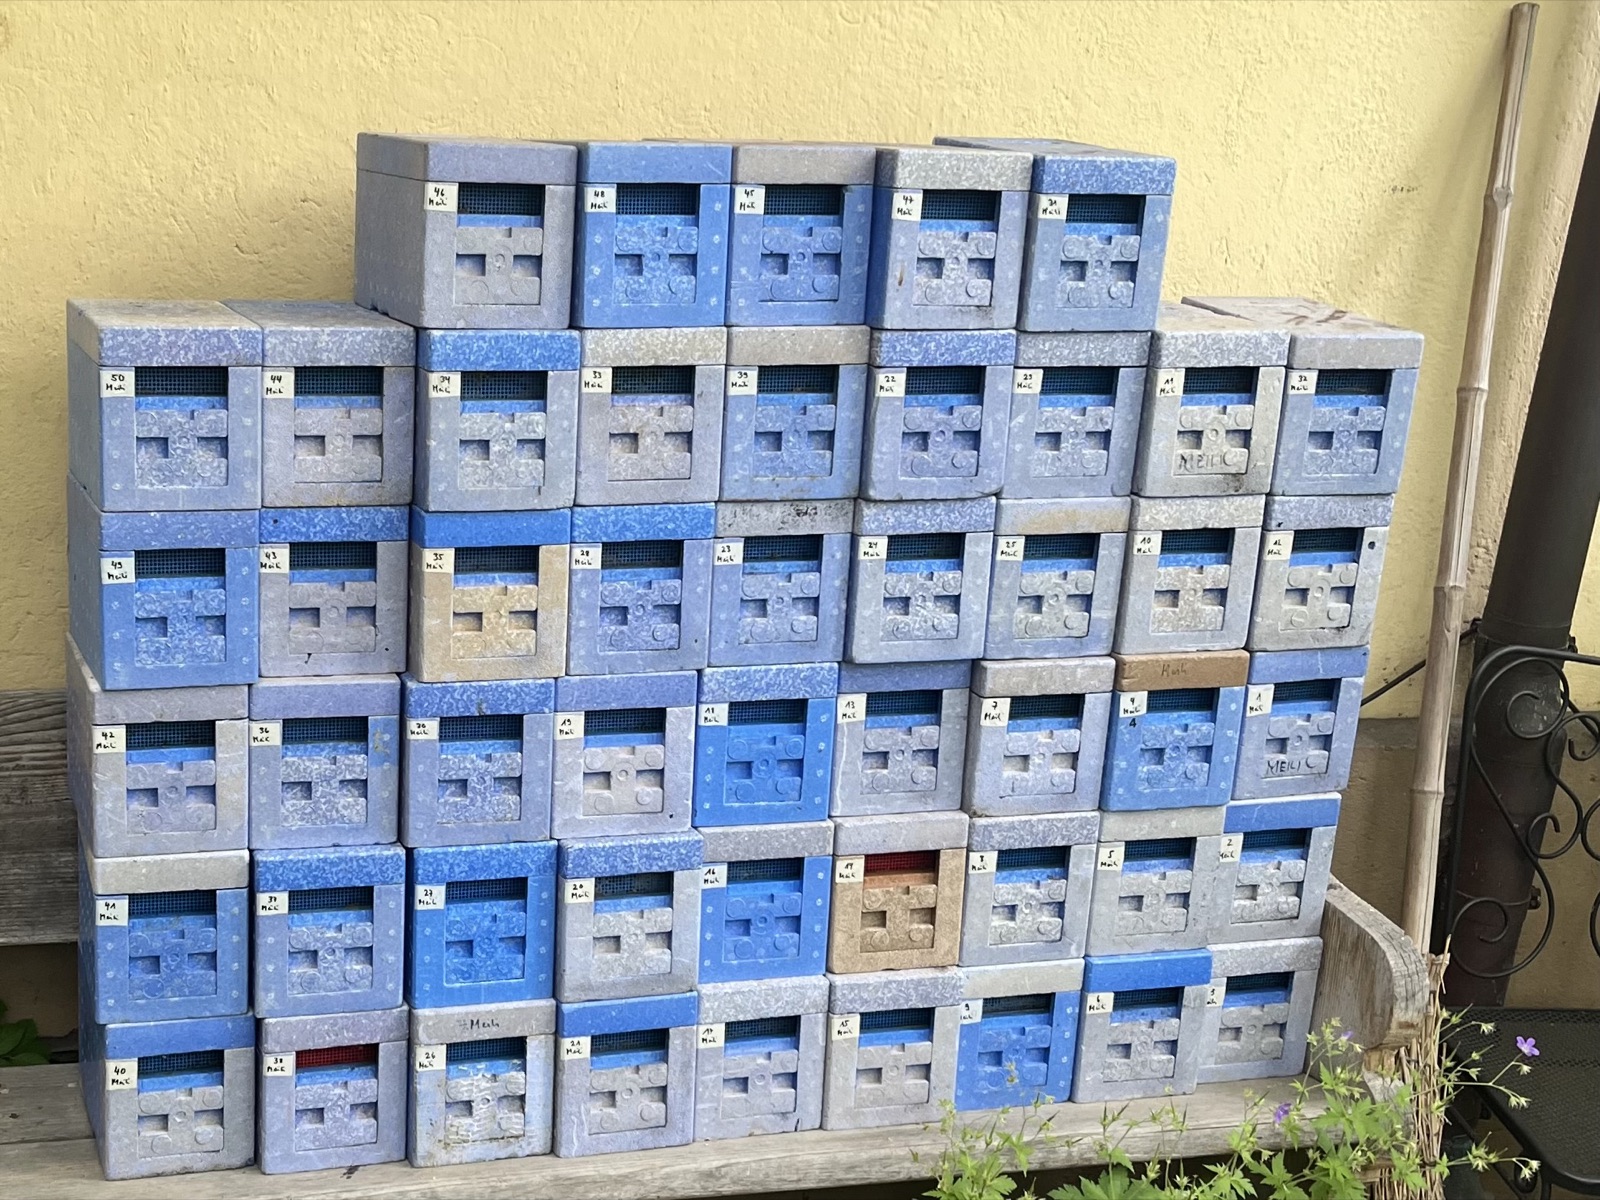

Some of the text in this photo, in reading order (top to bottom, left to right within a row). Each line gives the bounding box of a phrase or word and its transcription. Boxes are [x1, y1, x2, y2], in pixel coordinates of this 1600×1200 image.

[433, 186, 445, 198] 46
[593, 189, 605, 198] 48
[744, 188, 755, 199] 45
[902, 194, 915, 206] 47
[110, 373, 125, 382] 50
[270, 374, 283, 384] 44
[592, 370, 602, 379] 33
[737, 371, 749, 379] 39
[884, 375, 896, 383] 22
[1023, 373, 1033, 381] 29
[1298, 374, 1308, 383] 32
[439, 375, 451, 385] 34
[868, 541, 878, 549] 24
[1005, 541, 1017, 549] 25
[1140, 536, 1152, 545] 10
[580, 549, 590, 557] 28
[721, 544, 731, 553] 23
[264, 551, 278, 561] 43
[432, 552, 445, 562] 35
[110, 560, 123, 570] 49
[845, 700, 856, 709] 13
[560, 718, 572, 727] 19
[1129, 717, 1137, 728] 4
[258, 726, 270, 735] 36
[101, 731, 116, 741] 42
[1266, 760, 1301, 776] MEILI
[704, 868, 716, 876] 16
[423, 888, 433, 898] 27
[267, 895, 278, 904] 37
[104, 901, 116, 911] 41
[839, 1019, 850, 1028] 15
[424, 1051, 436, 1060] 26
[113, 1065, 127, 1076] 40
